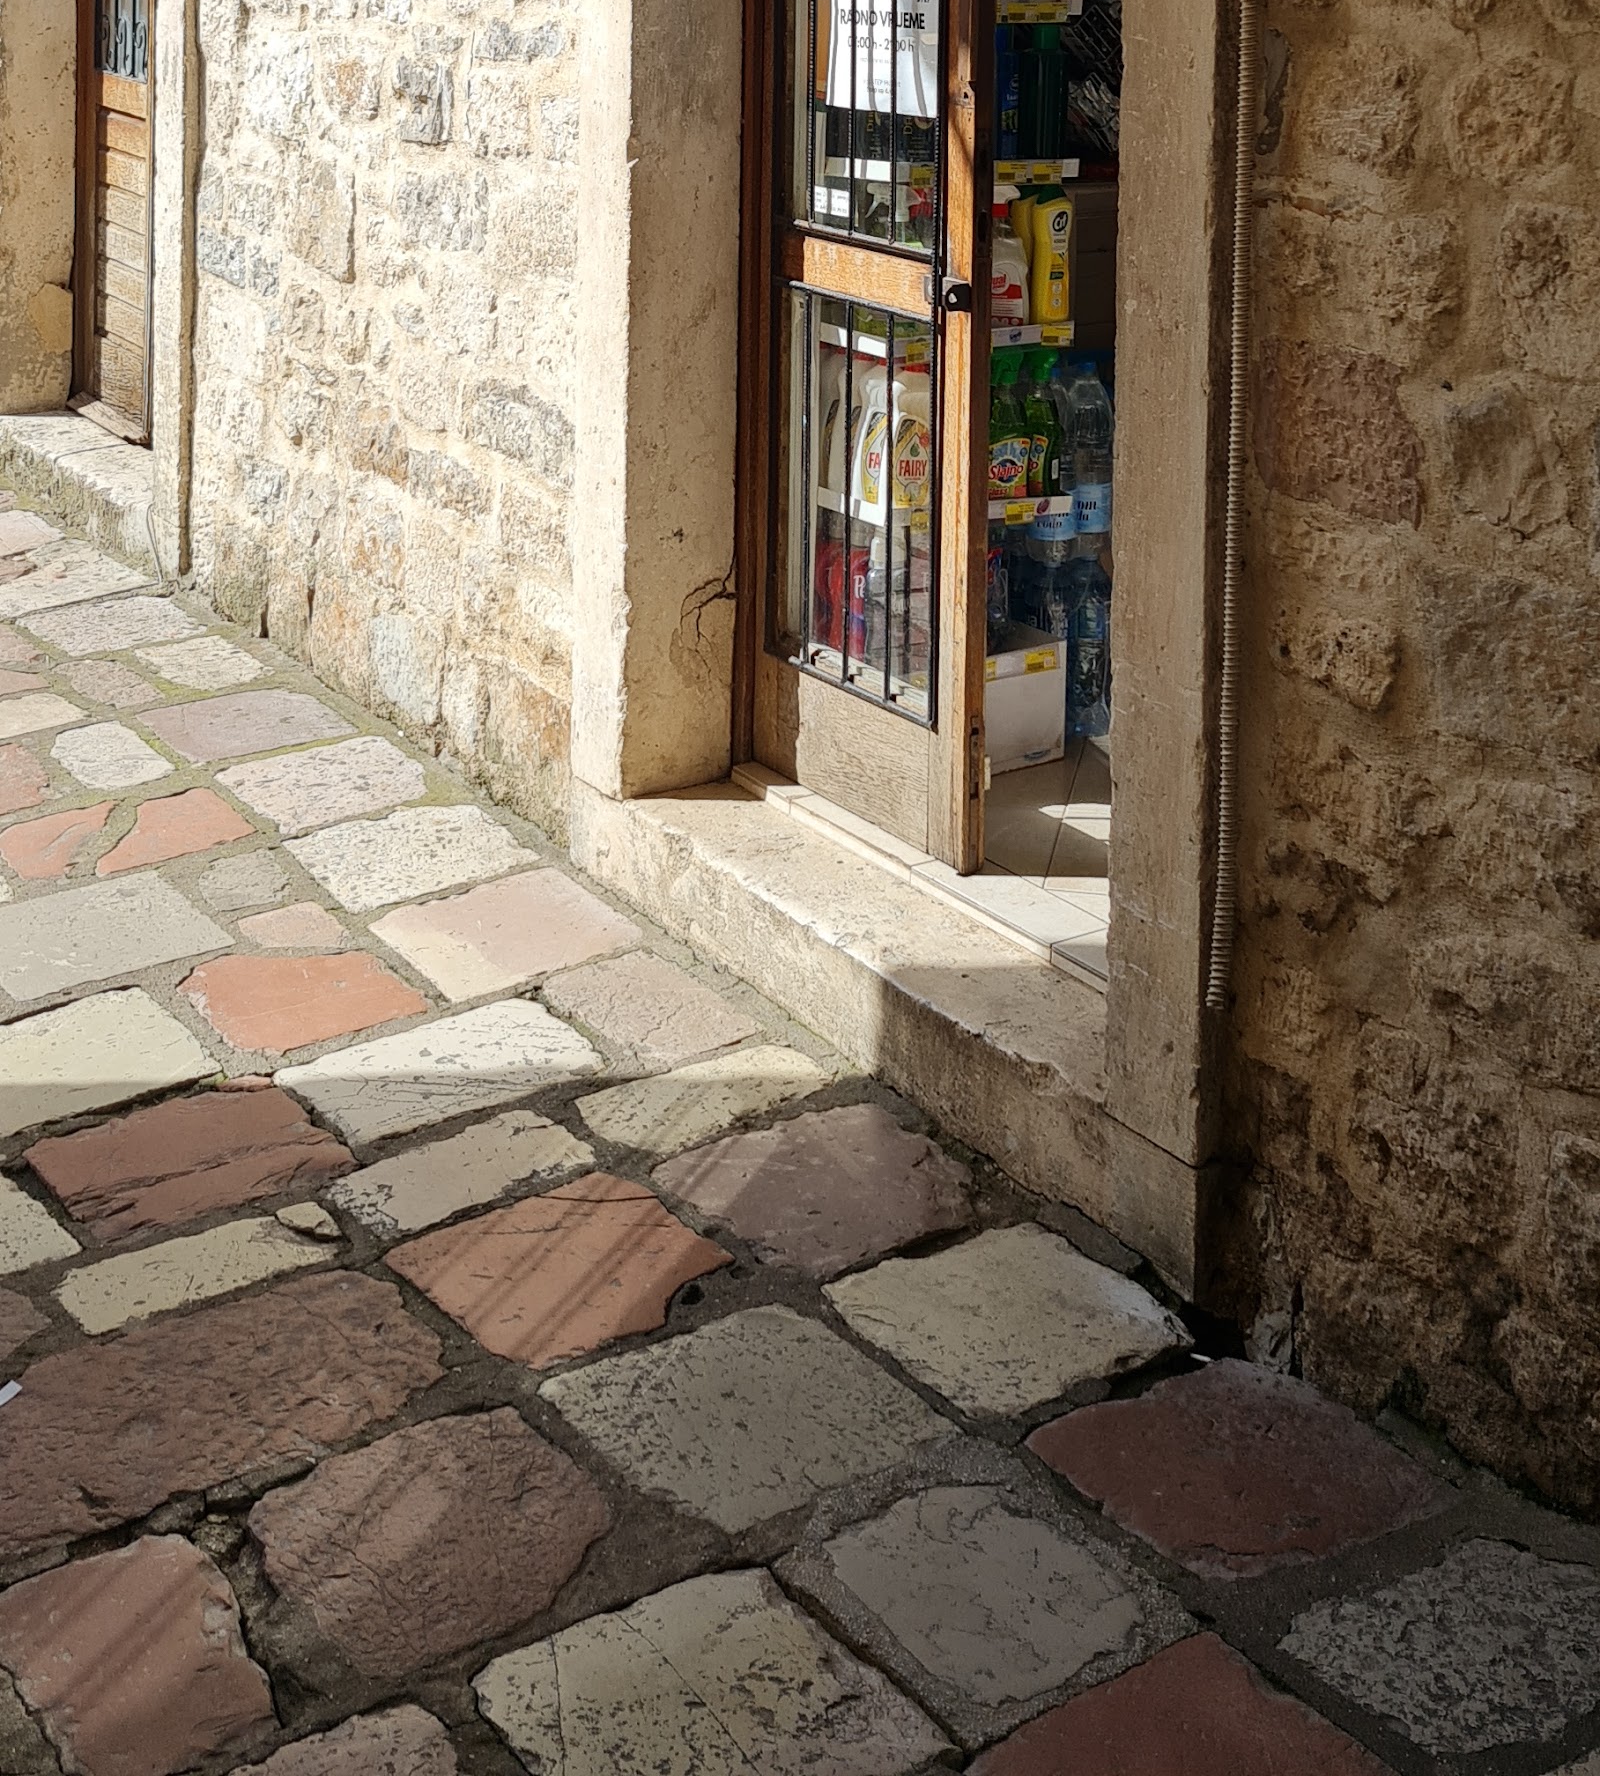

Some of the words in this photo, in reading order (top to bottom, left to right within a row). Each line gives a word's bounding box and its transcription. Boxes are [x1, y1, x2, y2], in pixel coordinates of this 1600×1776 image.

[879, 10, 926, 30] VRJEME
[1053, 216, 1068, 231] Cif
[899, 460, 928, 477] FAIRY
